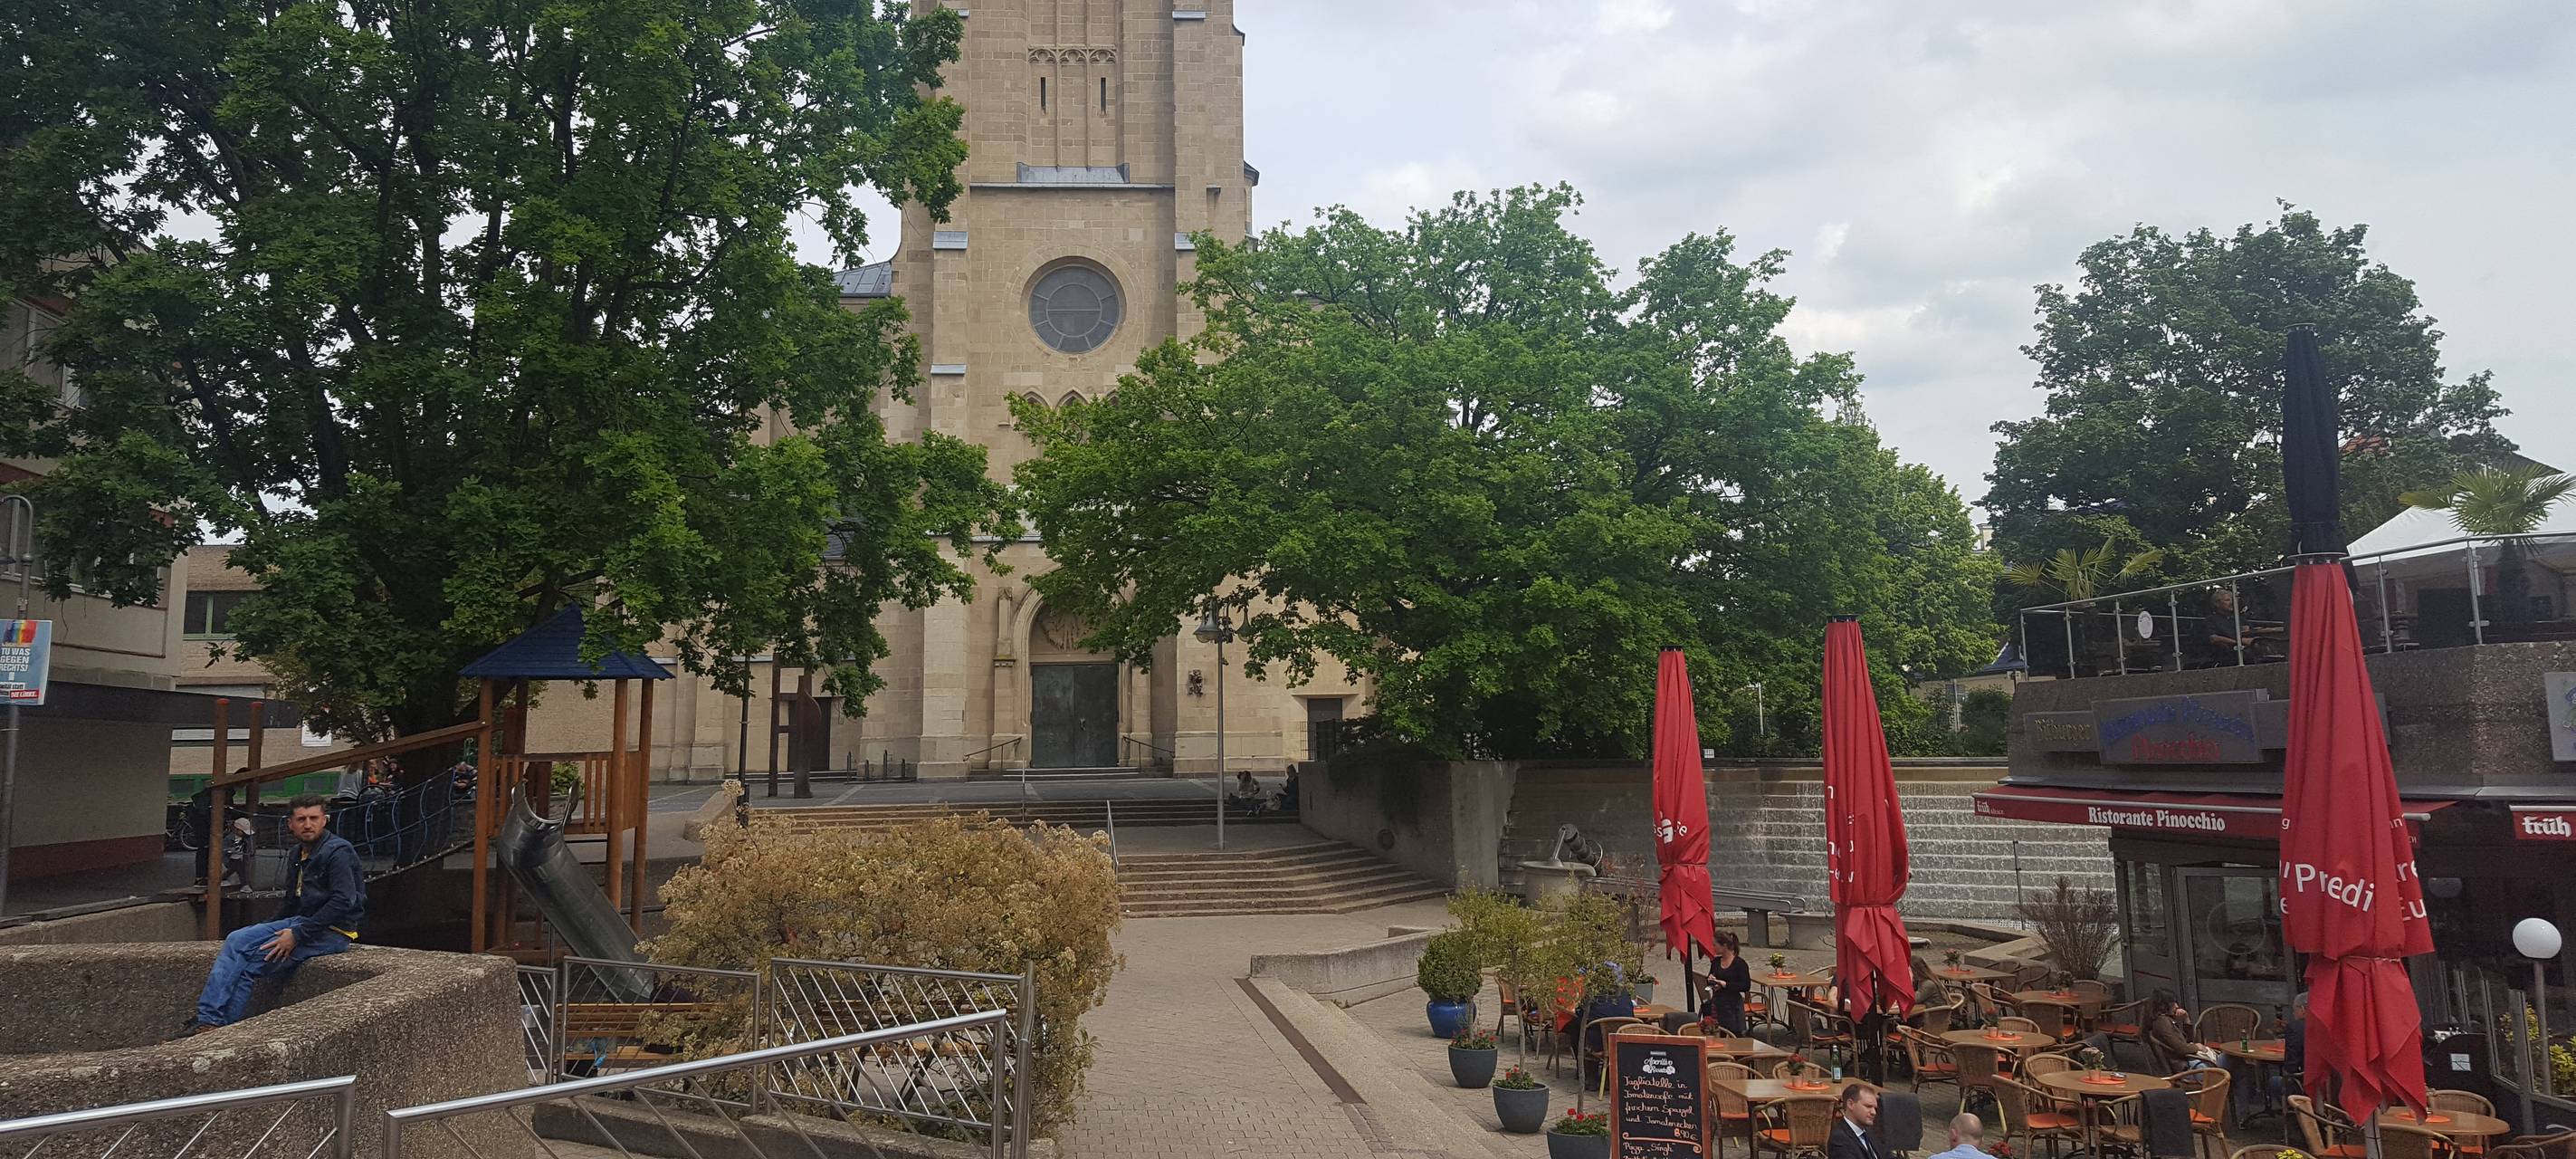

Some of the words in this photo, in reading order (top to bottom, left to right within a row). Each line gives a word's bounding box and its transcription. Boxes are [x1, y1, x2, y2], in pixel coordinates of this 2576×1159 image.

[2, 647, 10, 656] TU
[12, 647, 31, 656] WAS
[0, 656, 30, 664] GEGEN
[2087, 806, 2154, 827] Ristorante
[2155, 809, 2226, 831] Pinocchio
[1623, 1075, 1674, 1090] Tagliatelle
[1676, 1079, 1688, 1088] in
[1678, 1092, 1693, 1100] mit
[1625, 1101, 1660, 1116] frischem
[1662, 1104, 1694, 1118] Spargel
[1626, 1114, 1641, 1123] und
[1623, 1142, 1644, 1155] Pizza
